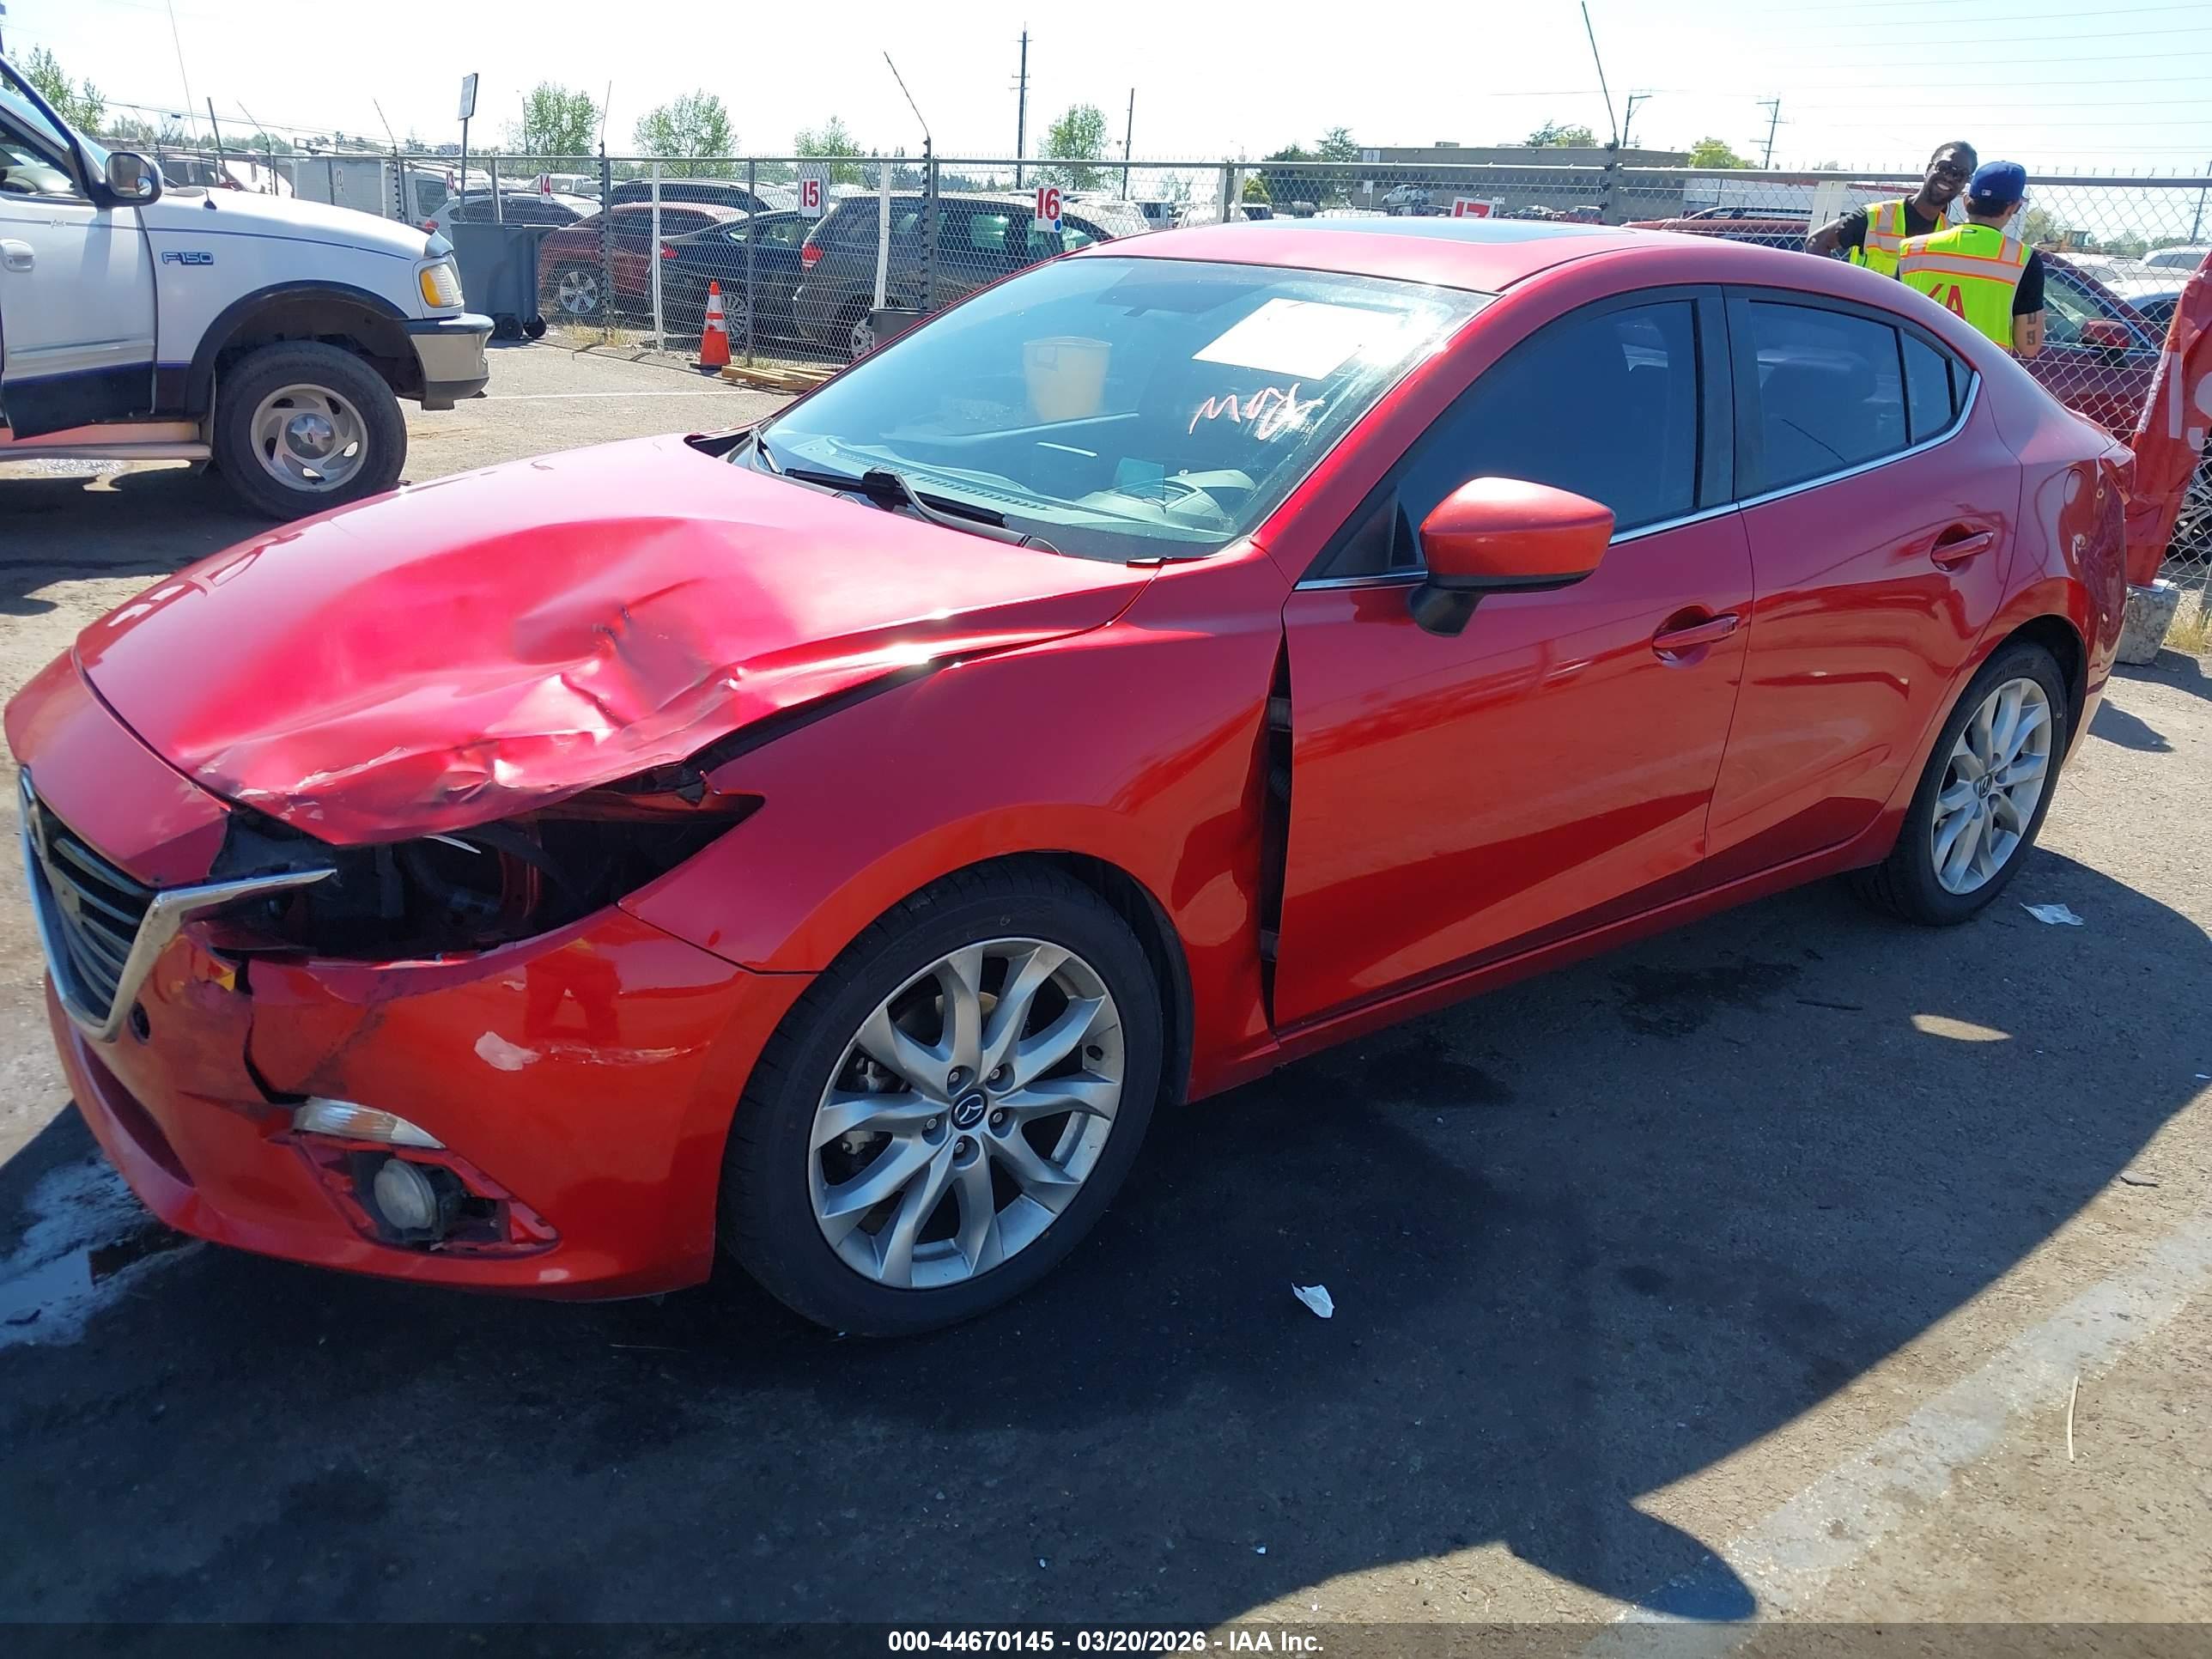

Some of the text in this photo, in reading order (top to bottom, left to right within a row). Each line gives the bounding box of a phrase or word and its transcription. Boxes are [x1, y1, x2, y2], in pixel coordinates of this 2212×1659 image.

[447, 172, 454, 190] 13
[540, 174, 550, 196] 14
[803, 181, 819, 207] 15
[1037, 187, 1060, 221] 16
